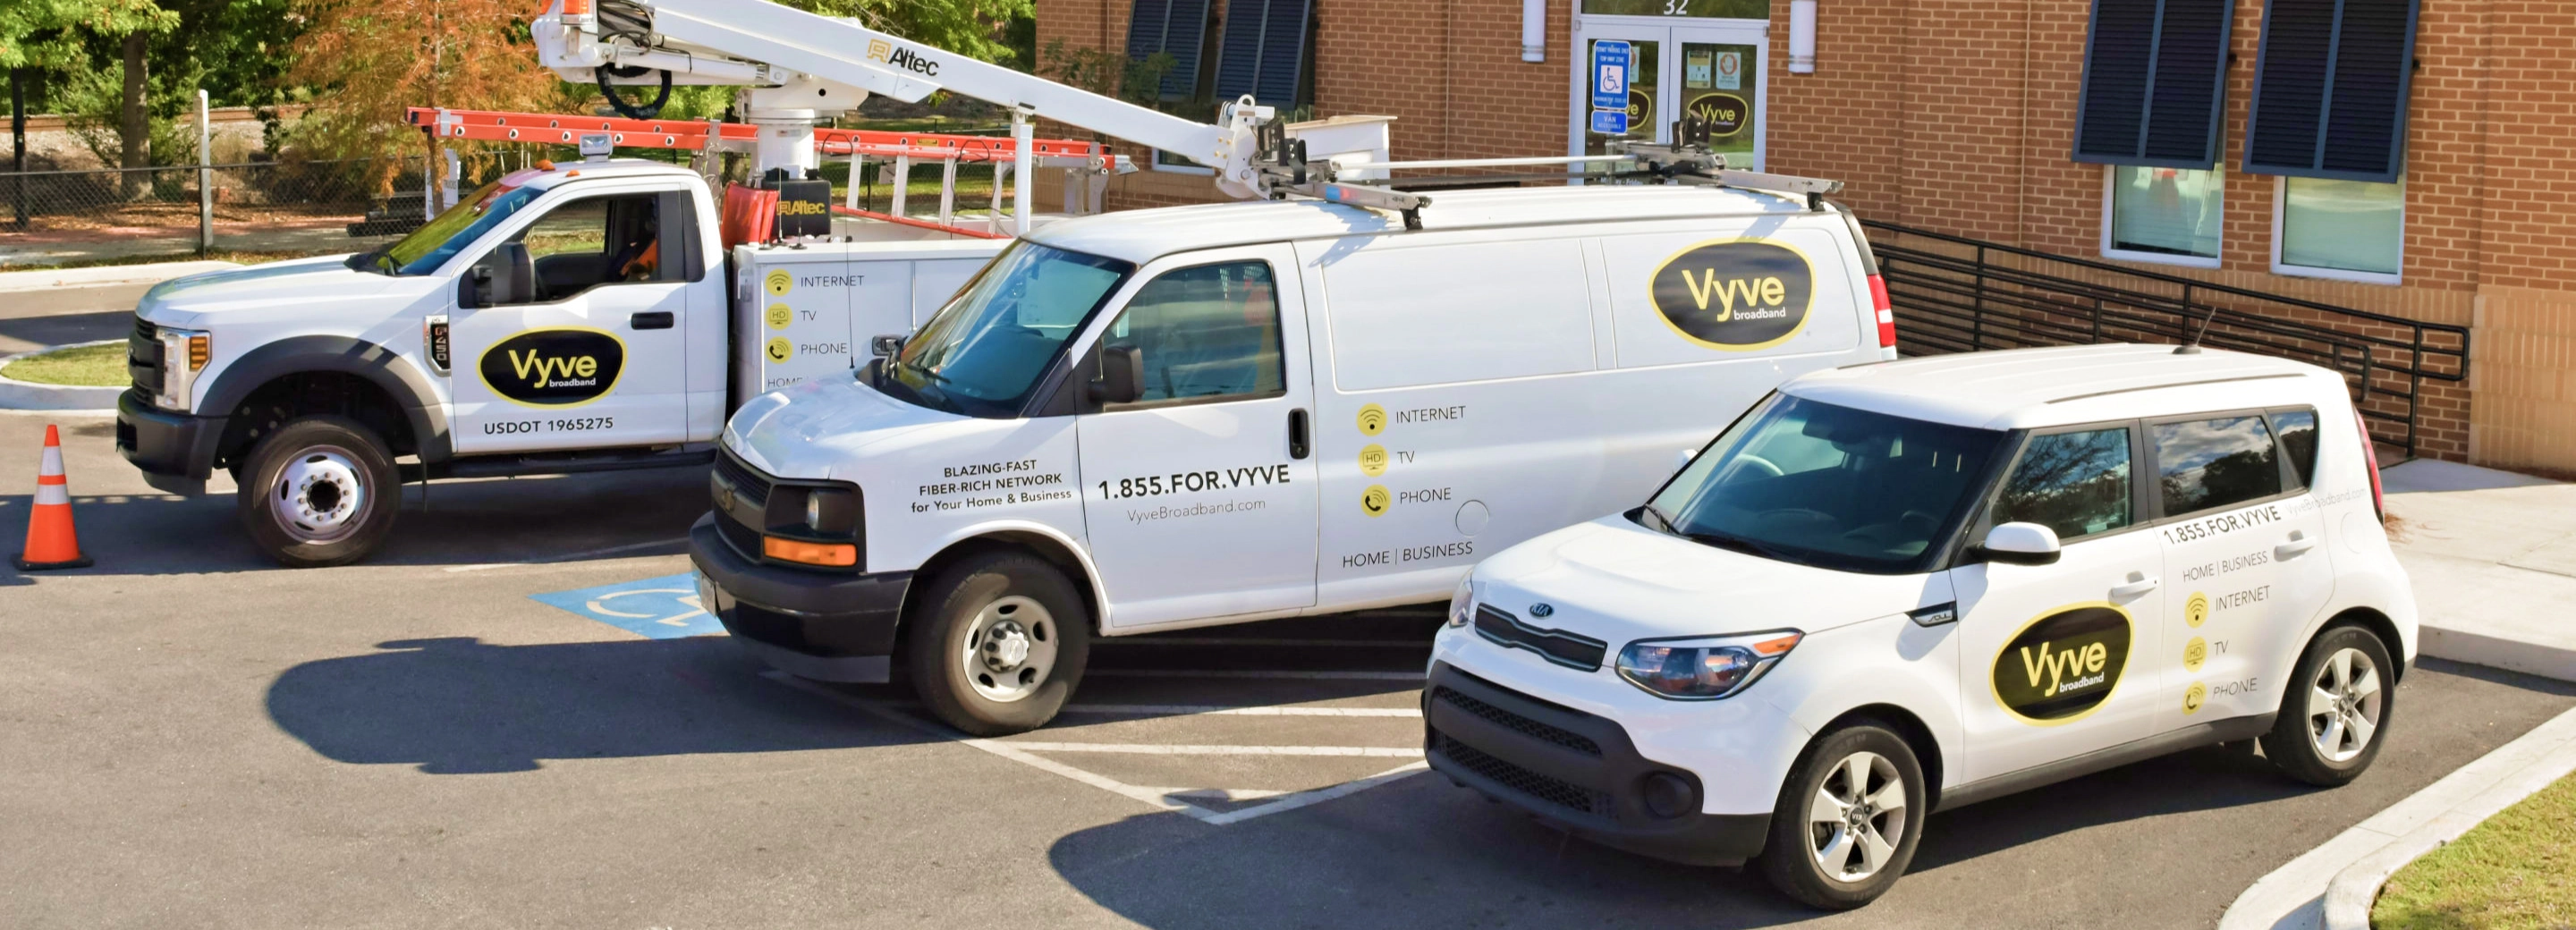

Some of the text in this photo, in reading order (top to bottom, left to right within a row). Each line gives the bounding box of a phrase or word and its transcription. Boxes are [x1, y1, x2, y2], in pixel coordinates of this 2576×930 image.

[1663, 0, 1689, 15] 32
[887, 46, 940, 77] Altec
[1604, 115, 1616, 123] VAN
[1699, 103, 1736, 124] Vyve
[791, 200, 826, 215] Altec
[801, 275, 865, 287] INTERNET
[1681, 268, 1785, 322] Vyve
[772, 311, 786, 319] HD
[801, 310, 817, 321] TV
[1733, 307, 1786, 321] broadband
[801, 342, 848, 355] PHONE
[508, 349, 597, 389] Vyve
[549, 377, 597, 388] broadband
[1395, 406, 1466, 424] INTERNET
[484, 417, 614, 435] USDOT 1965275
[1366, 453, 1381, 463] HD
[1397, 451, 1415, 464] TV
[944, 460, 1037, 478] BLAZING-FAST
[919, 473, 1063, 496] FIBER-RICH NETWORK
[1098, 463, 1291, 500] 1.855.FOR.VYVE
[911, 490, 1072, 513] for Your Home & Business
[1400, 487, 1452, 505] PHONE
[1127, 499, 1266, 525] VyveBroadband.com
[2164, 505, 2282, 545] 1.855.FOR.VYVE
[1343, 541, 1474, 569] HOME BUSINESS
[2182, 551, 2268, 582] HOME BUSINESS
[2216, 585, 2270, 612] INTERNET
[1530, 604, 1549, 616] KIA
[2189, 647, 2202, 658] HD
[2214, 639, 2229, 655] TV
[2021, 641, 2106, 697] Vyve
[2059, 672, 2105, 693] broadband
[2213, 677, 2258, 699] PHONE
